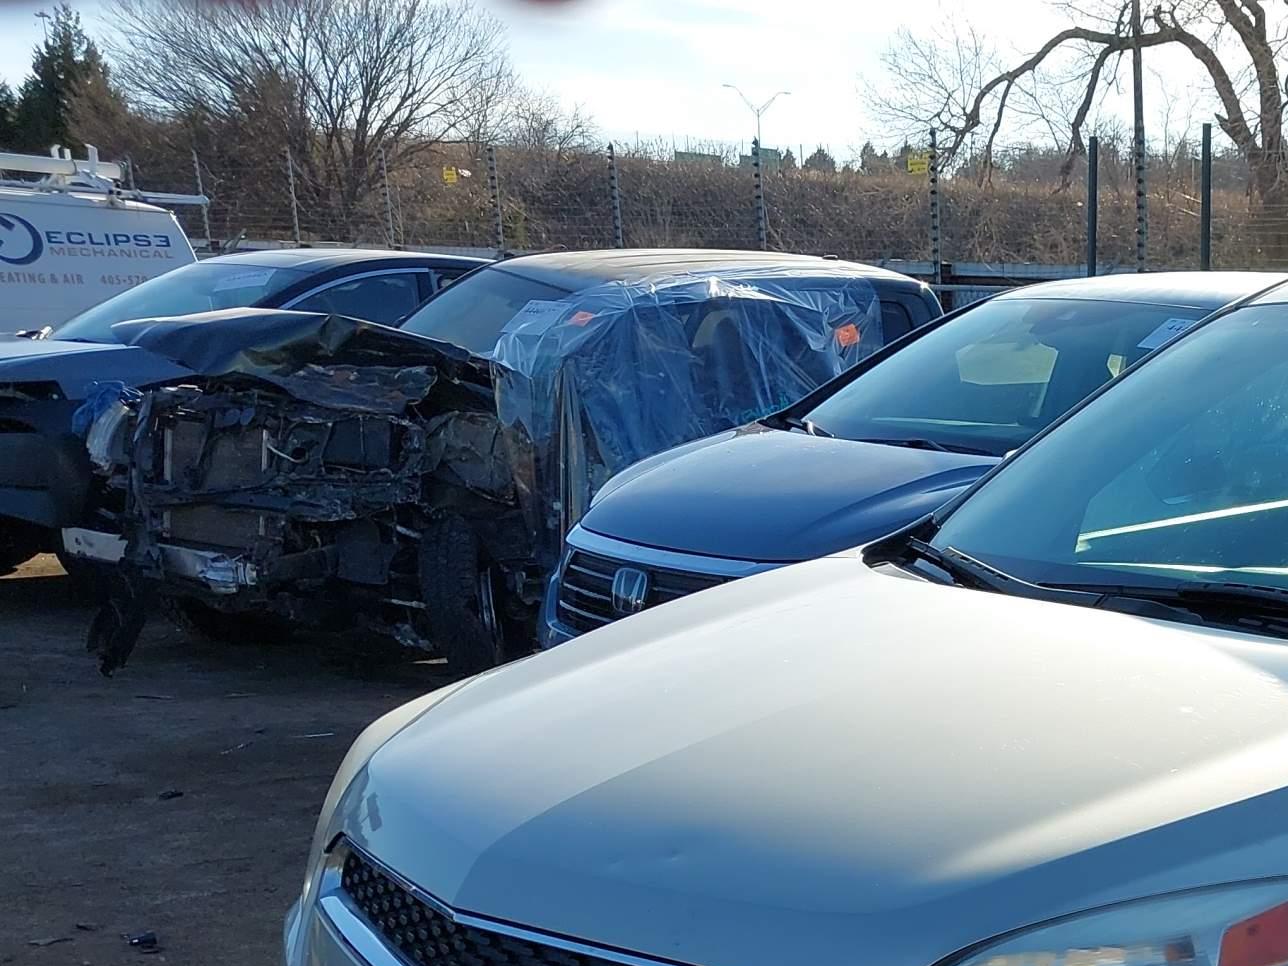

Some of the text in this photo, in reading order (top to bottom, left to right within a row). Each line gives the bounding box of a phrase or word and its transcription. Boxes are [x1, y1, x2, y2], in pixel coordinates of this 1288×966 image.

[48, 246, 175, 259] MECHANICAL
[49, 273, 58, 284] &
[63, 273, 84, 285] AIR
